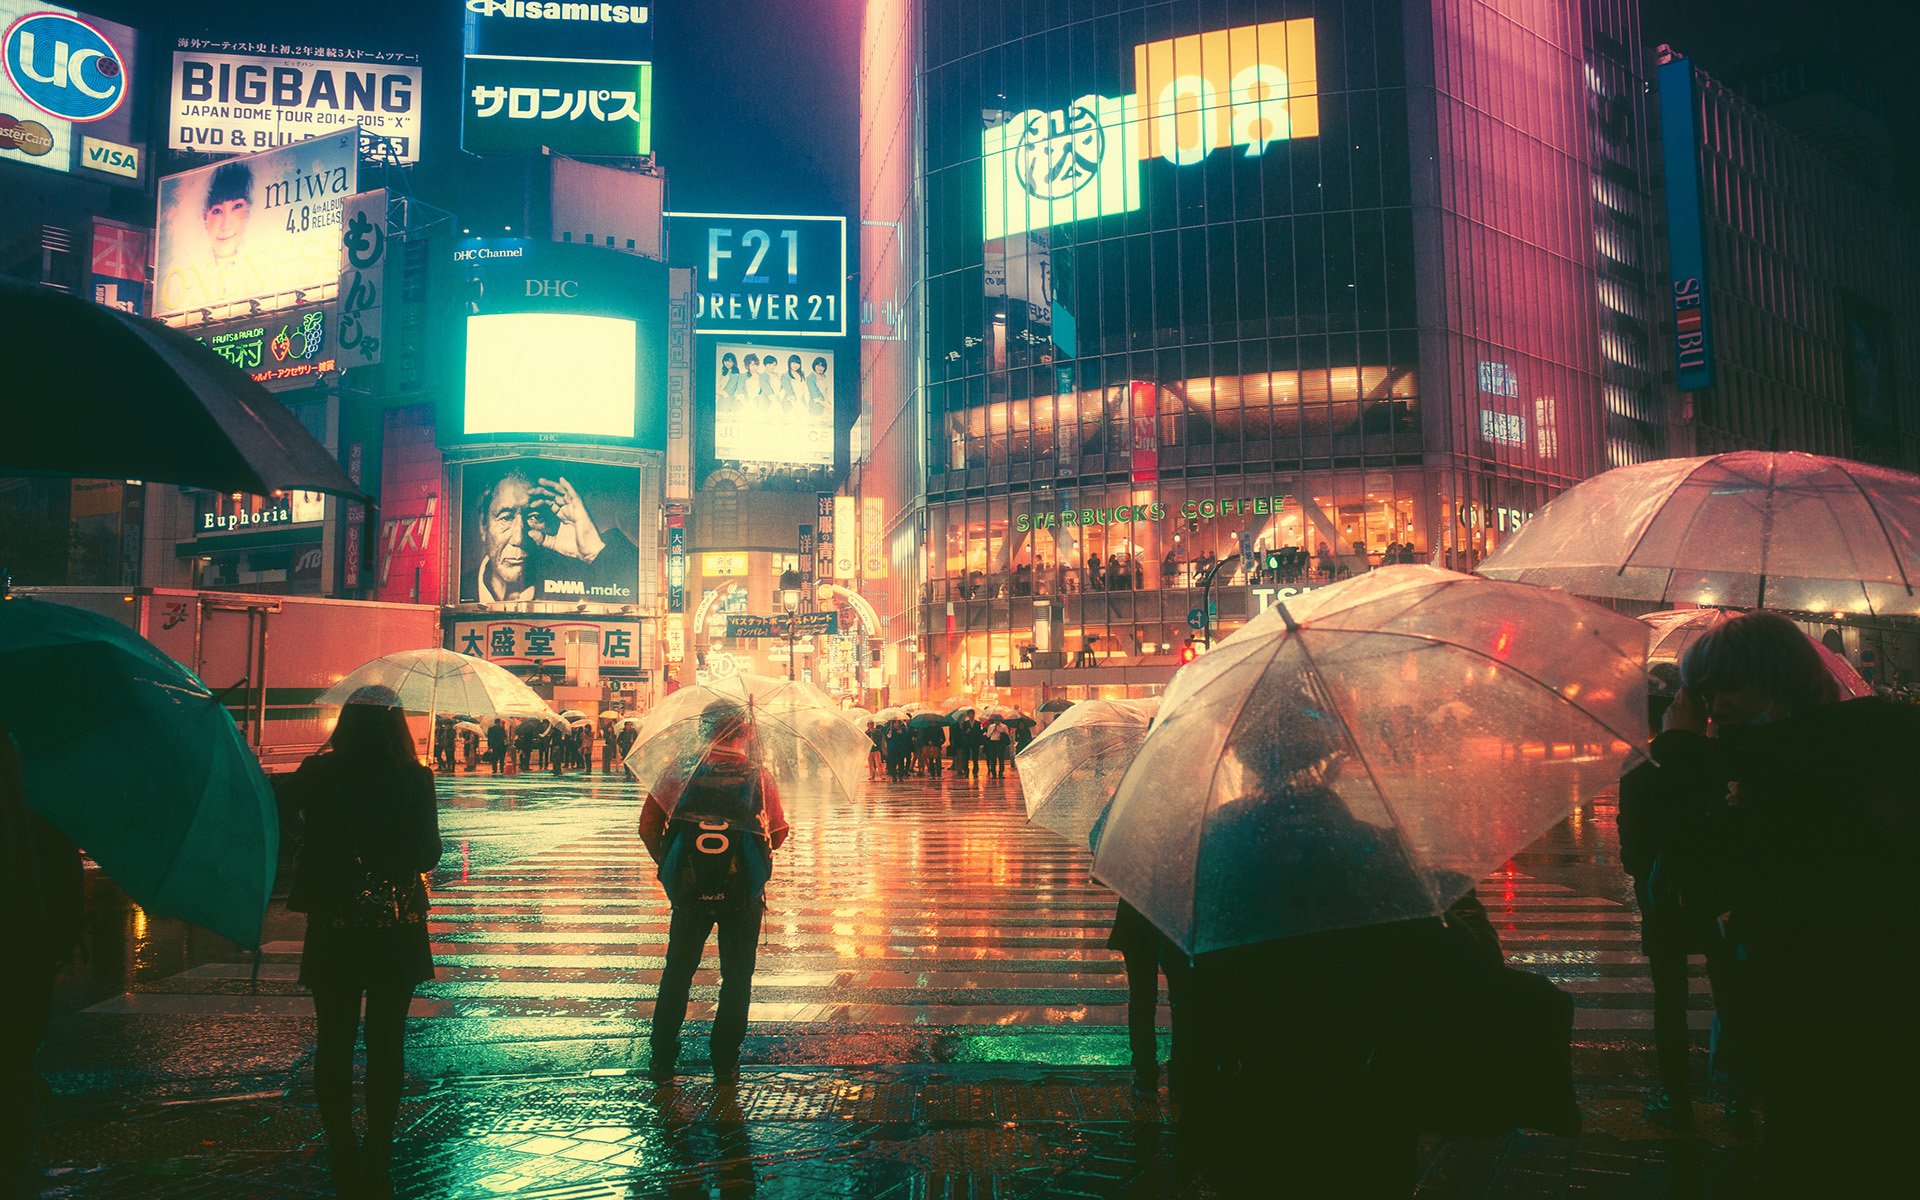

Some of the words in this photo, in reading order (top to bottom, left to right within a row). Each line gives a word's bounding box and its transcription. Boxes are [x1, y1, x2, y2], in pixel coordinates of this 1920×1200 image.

[181, 61, 413, 113] BIGBANG
[181, 105, 229, 118] JAPAN
[233, 107, 272, 120] DOME
[277, 109, 313, 123] TOUR
[471, 85, 640, 122] サロンパス
[0, 123, 52, 147] asterCard
[180, 126, 224, 145] DVD
[230, 129, 247, 147] &
[89, 147, 137, 171] VISA
[264, 166, 349, 210] miwa
[286, 205, 310, 234] 4.8
[453, 250, 477, 261] DHC
[478, 247, 522, 259] Channel
[708, 228, 798, 284] F21
[338, 210, 384, 361] もんじゃ
[524, 280, 578, 298] DHC
[695, 293, 799, 320] OREVER
[807, 294, 835, 320] 21
[1674, 278, 1704, 369] SEIBU
[539, 433, 559, 442] DHC
[204, 506, 288, 530] Euphoria
[1016, 500, 1166, 532] STARBUCKS
[1181, 495, 1285, 518] COFFEE
[295, 551, 322, 574] JTB
[671, 534, 682, 607] 大盛堂ビル
[544, 579, 631, 597] DMM.make
[461, 627, 632, 658] 大盛堂店
